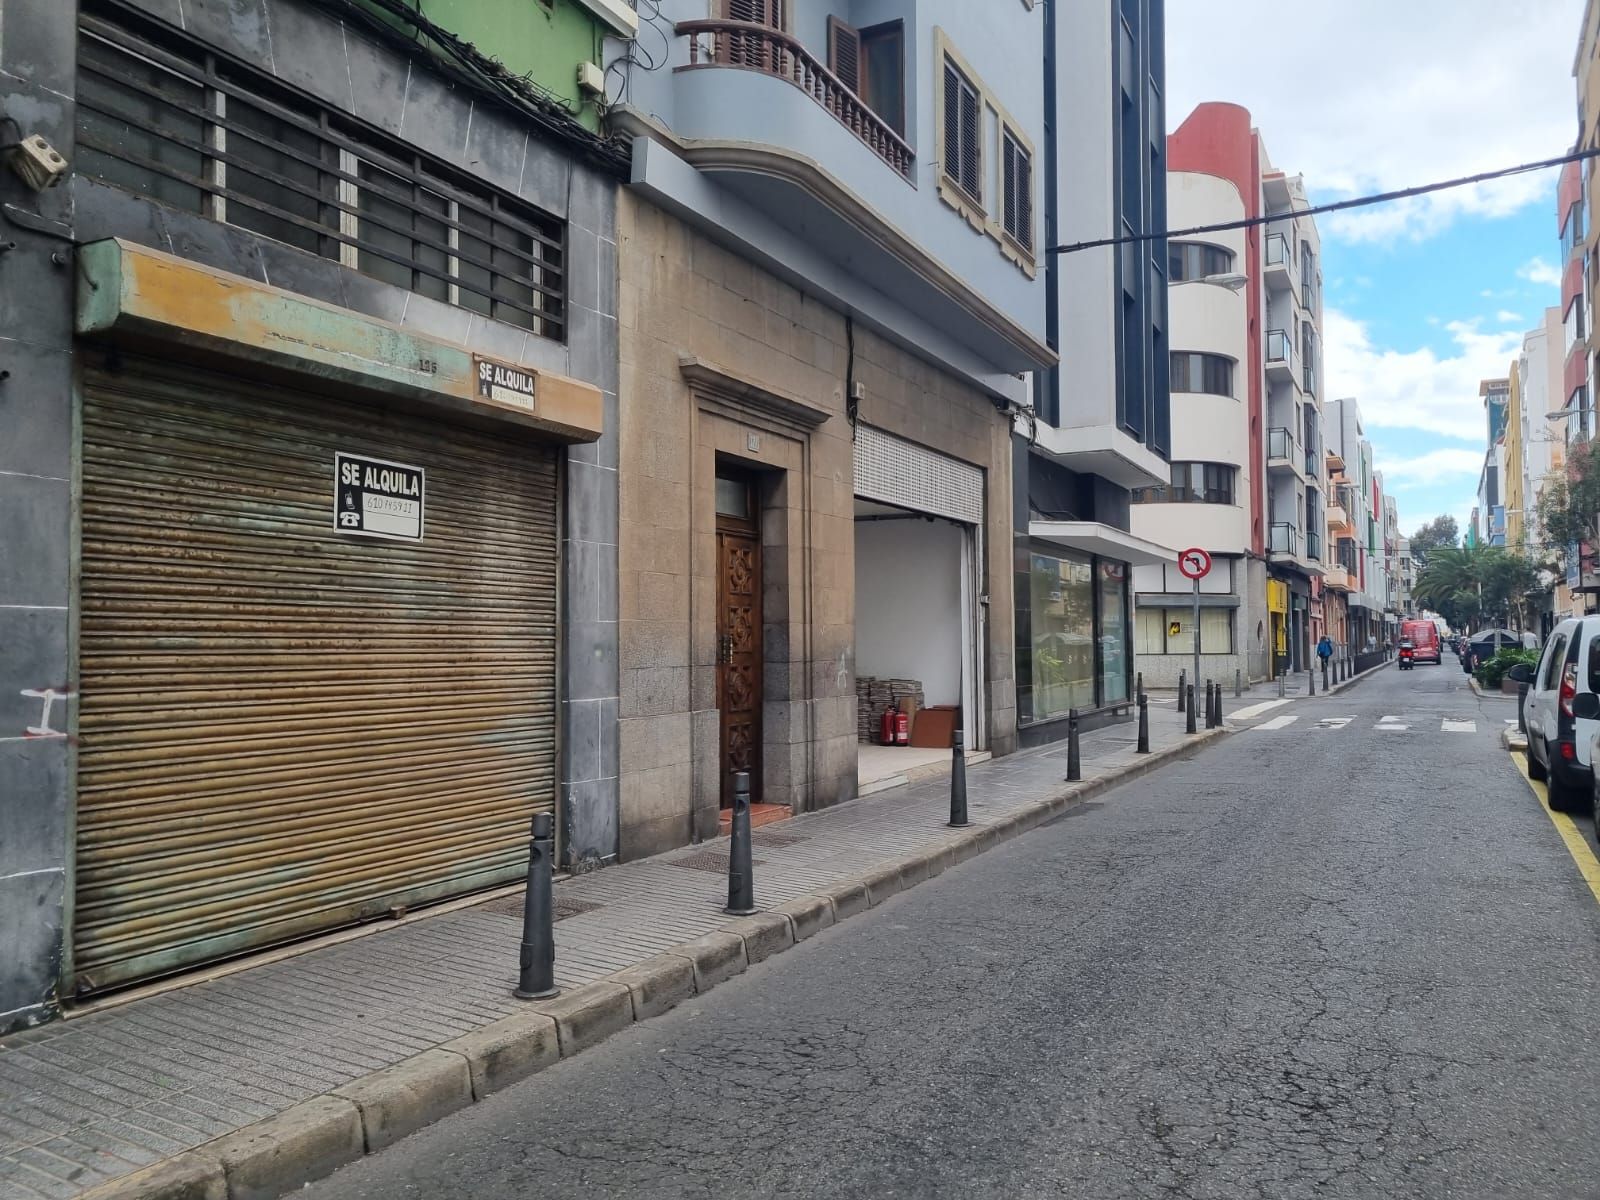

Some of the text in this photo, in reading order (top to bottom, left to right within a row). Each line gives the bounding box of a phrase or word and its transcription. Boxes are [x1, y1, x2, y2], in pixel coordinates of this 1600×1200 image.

[479, 362, 534, 394] SE ALQUILA
[341, 462, 420, 497] SE ALQUILA
